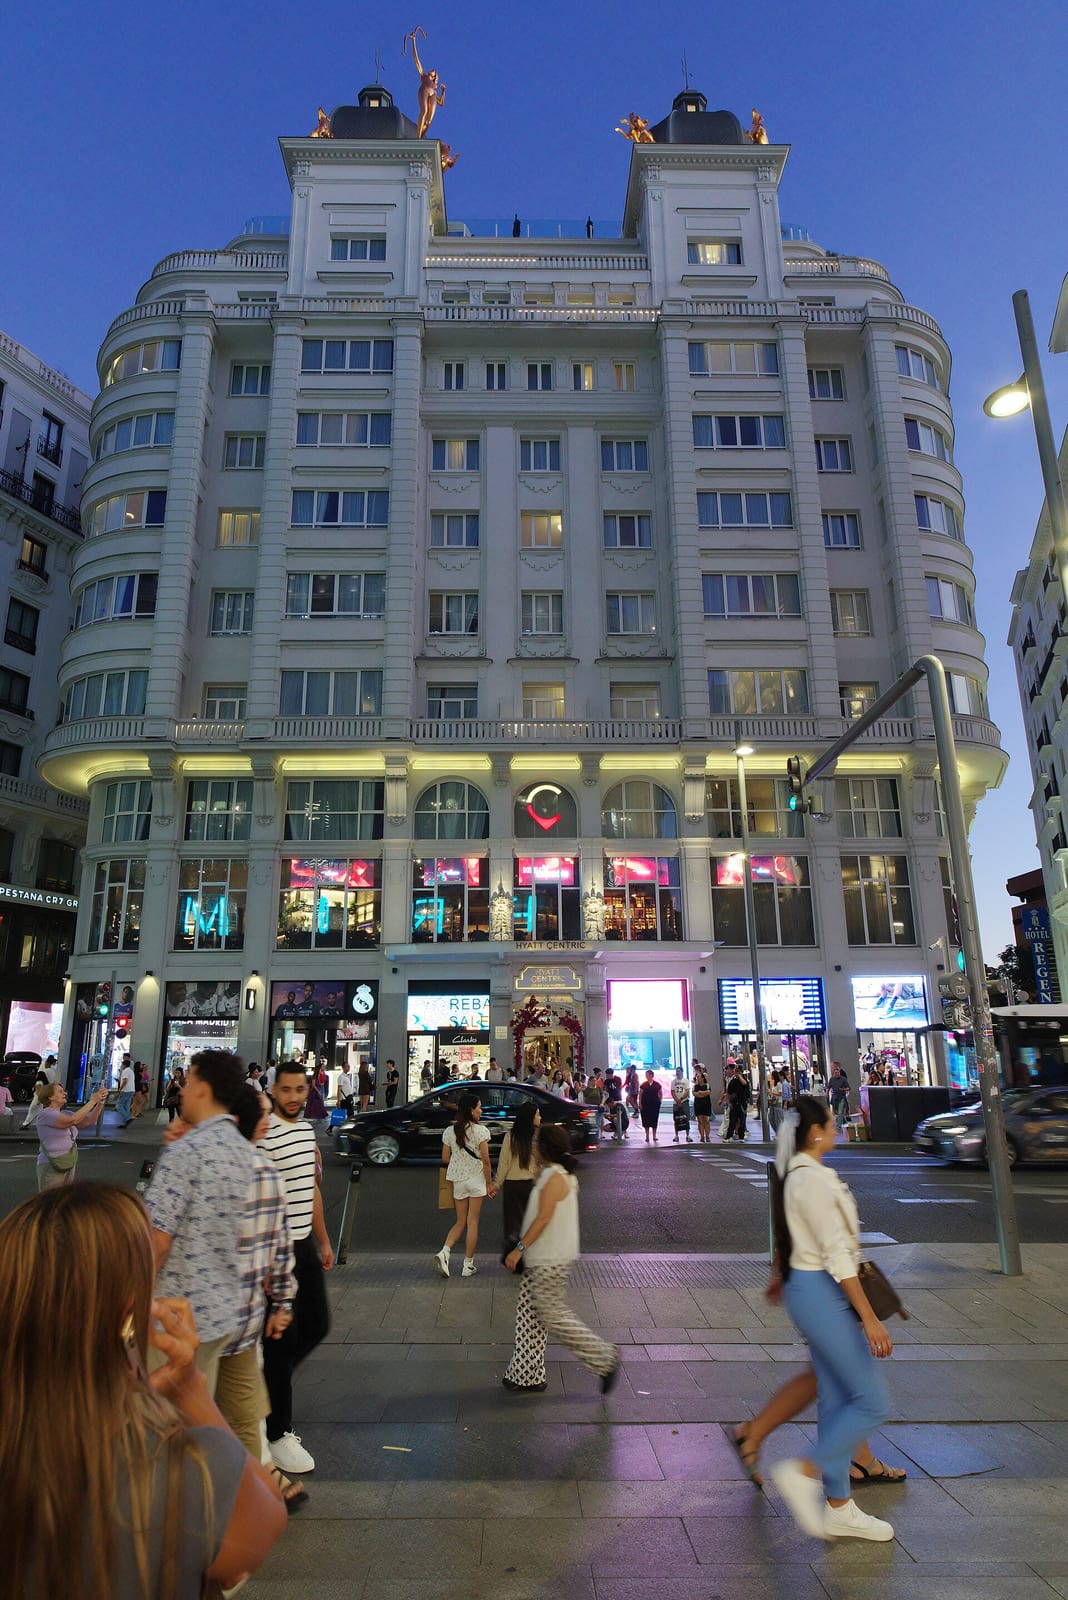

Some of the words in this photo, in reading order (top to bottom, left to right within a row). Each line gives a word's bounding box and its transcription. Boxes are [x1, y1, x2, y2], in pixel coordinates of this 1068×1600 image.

[0, 887, 43, 902] PESTANA
[45, 895, 64, 905] CR7
[1024, 930, 1050, 940] HOTEL
[515, 941, 544, 949] HYATT
[546, 941, 586, 950] CENTRIC
[451, 1035, 478, 1044] Clarks
